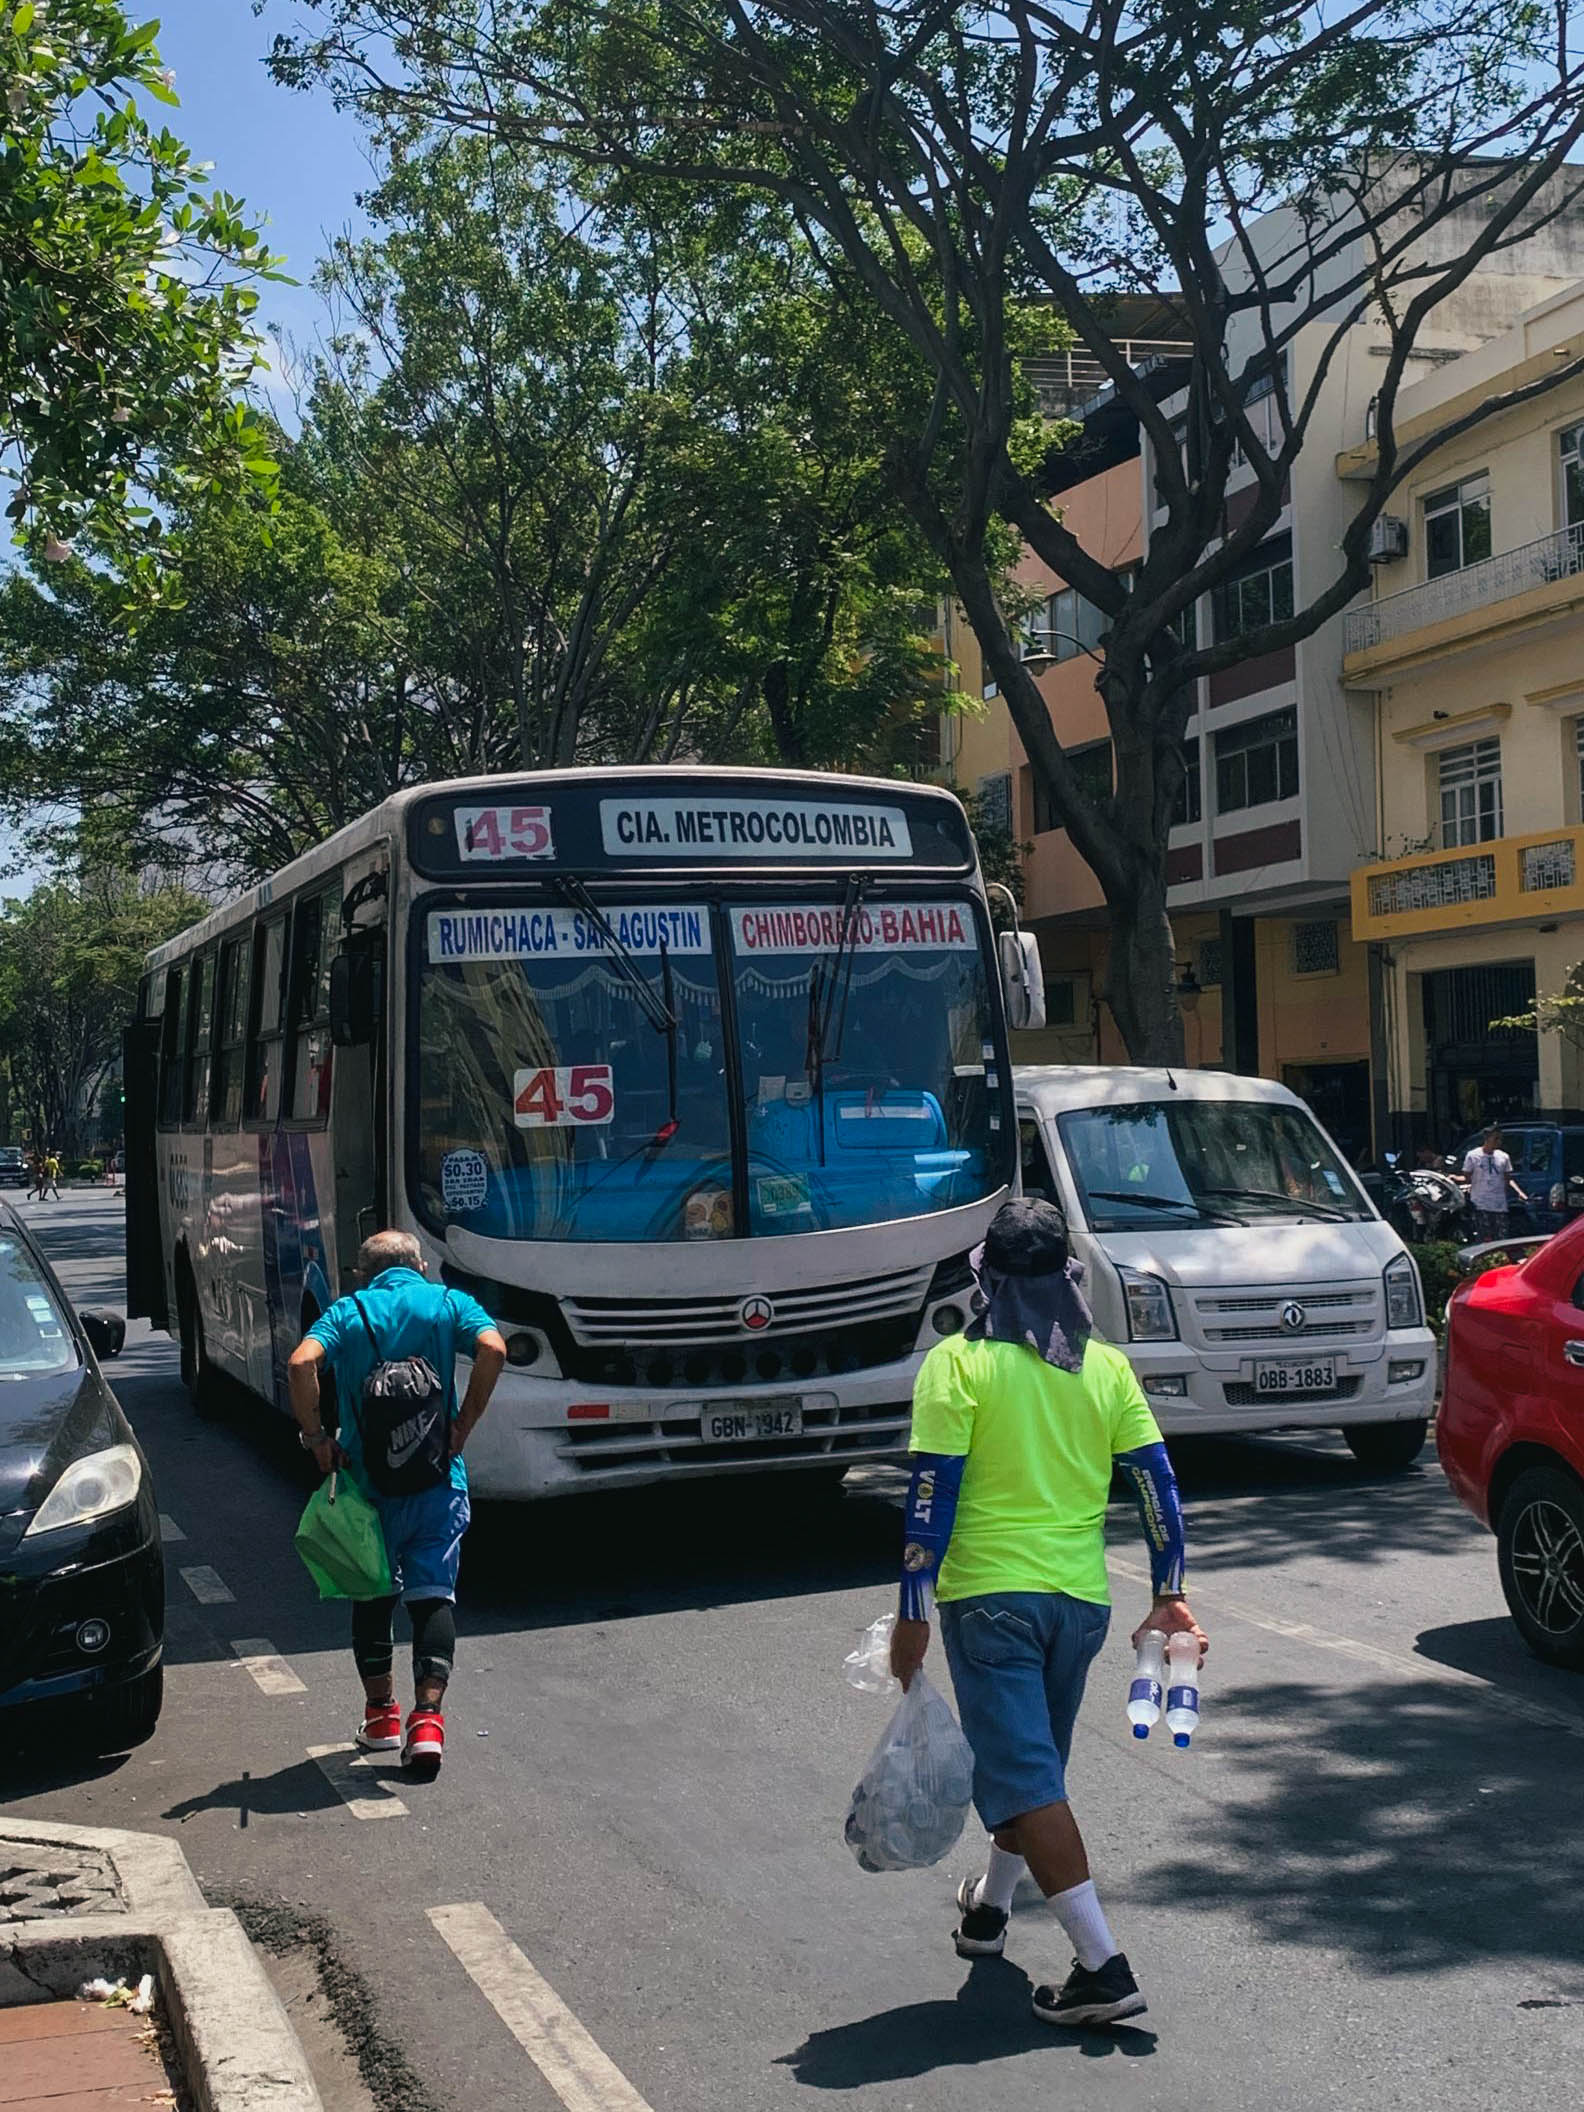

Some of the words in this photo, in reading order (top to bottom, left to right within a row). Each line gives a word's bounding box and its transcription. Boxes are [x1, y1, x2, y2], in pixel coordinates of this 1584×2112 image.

[465, 808, 549, 856] 45
[617, 811, 670, 844] CIA.
[675, 811, 896, 847] METROCOLOMBIA
[440, 914, 557, 954] RUMICHACA
[619, 912, 701, 949] AGUSTIN
[516, 1066, 612, 1122] 45
[444, 1161, 482, 1178] $0.30
[1259, 1367, 1333, 1390] OBB-1883
[391, 1410, 428, 1451] NIKE
[711, 1411, 794, 1439] GBN-1942
[914, 1470, 936, 1524] VOLT
